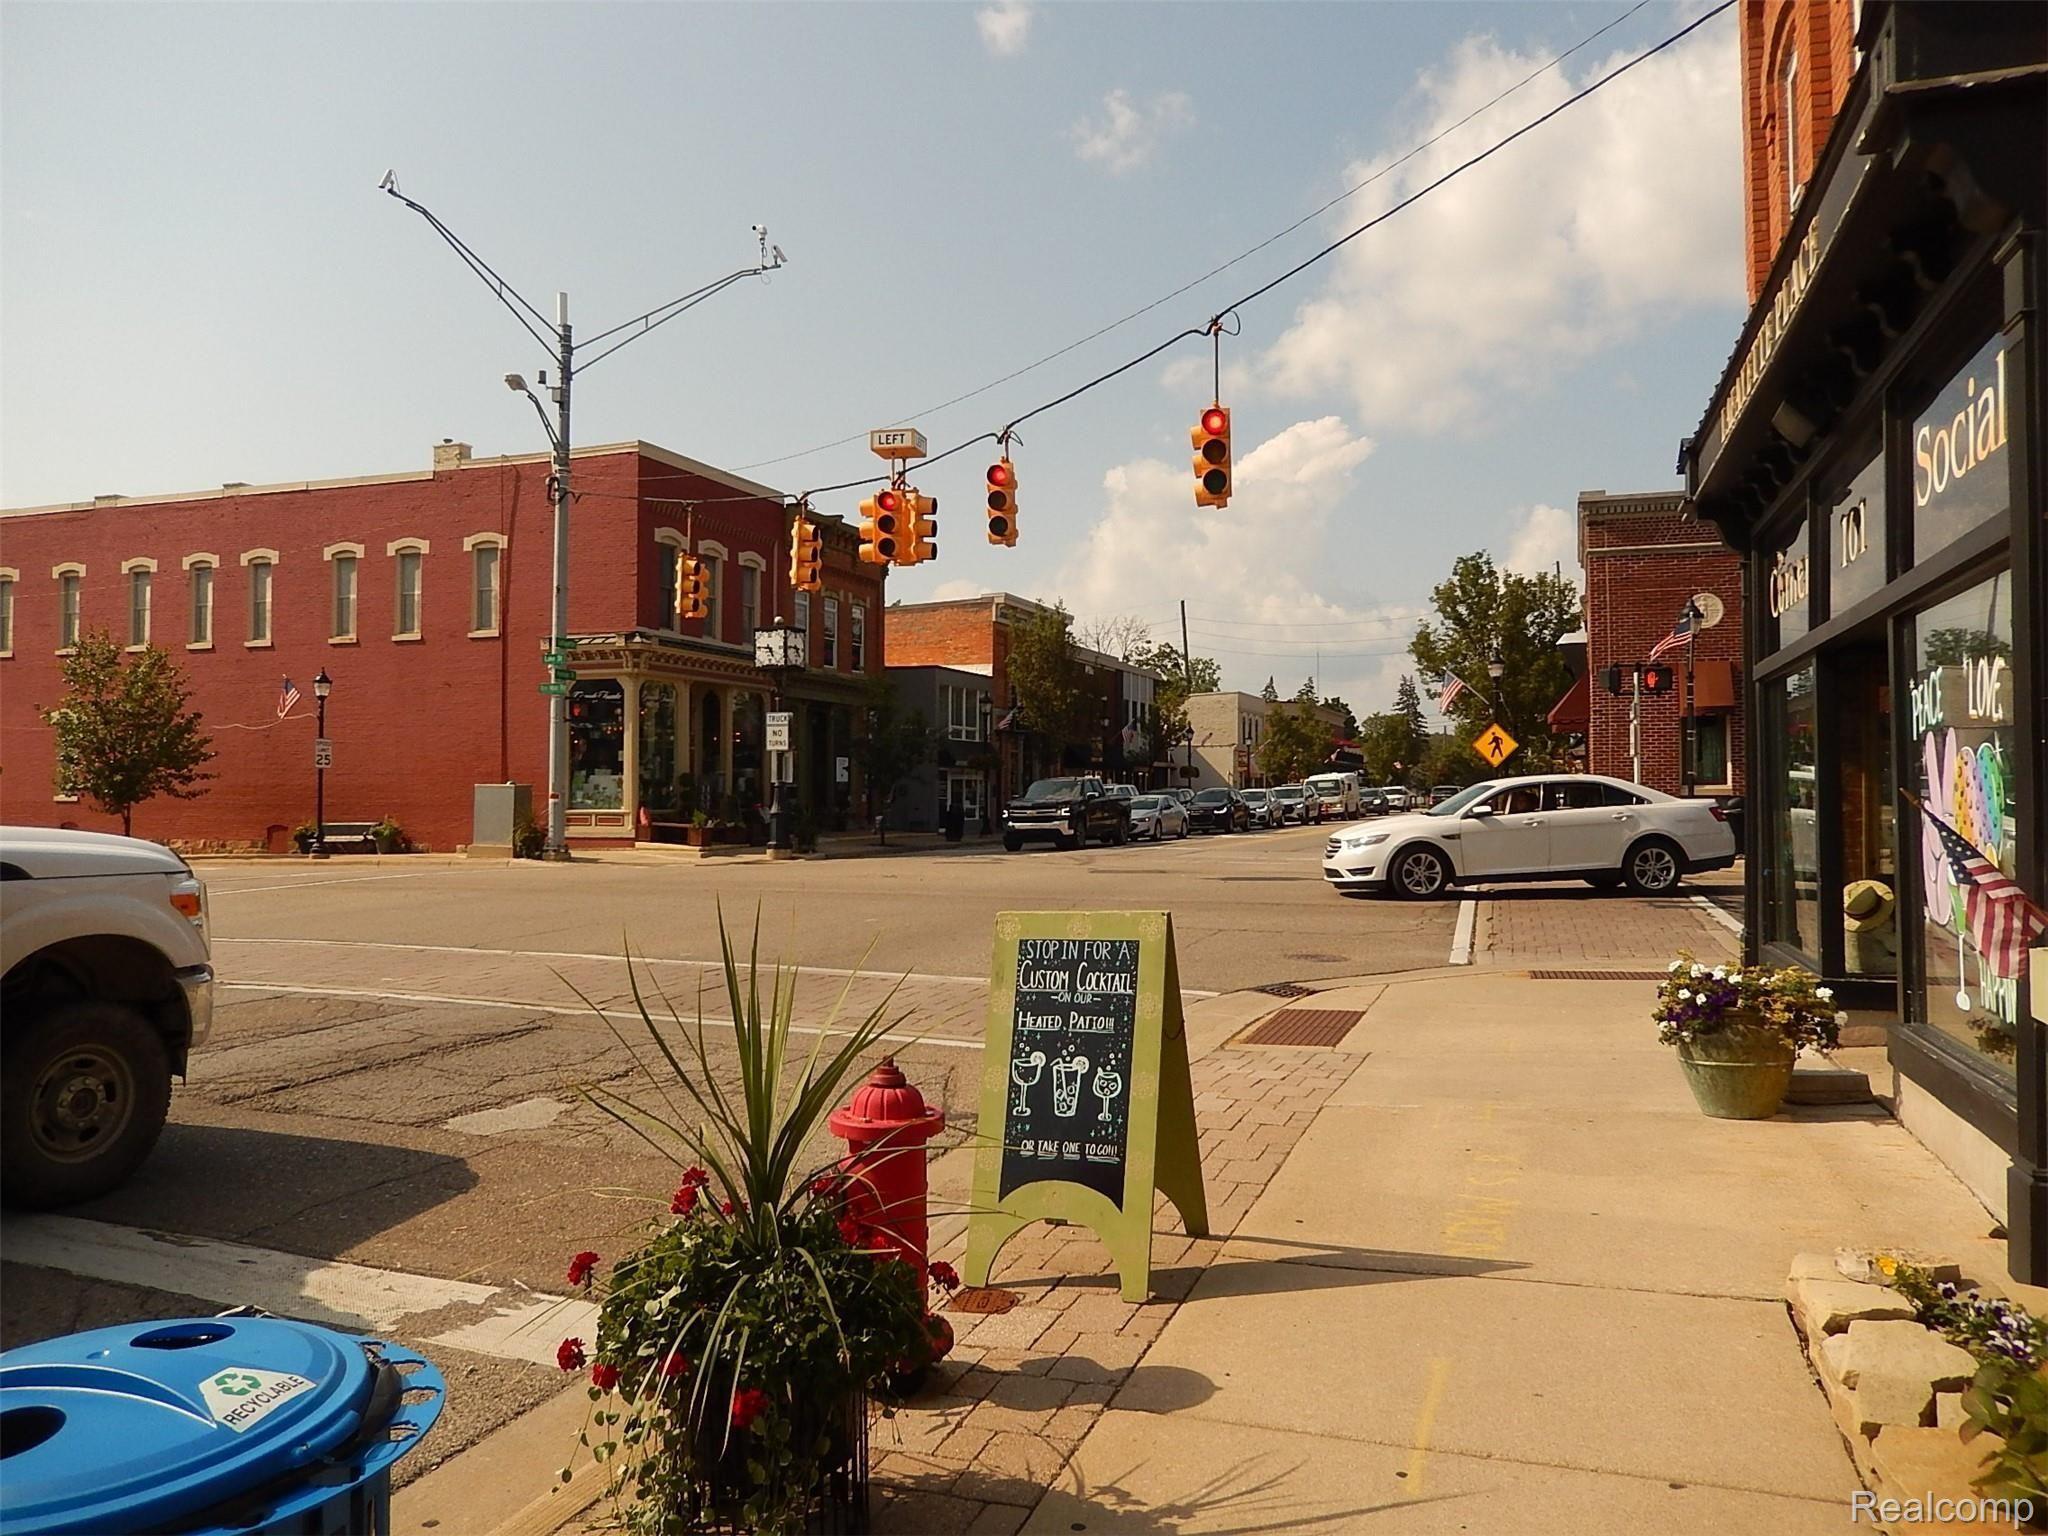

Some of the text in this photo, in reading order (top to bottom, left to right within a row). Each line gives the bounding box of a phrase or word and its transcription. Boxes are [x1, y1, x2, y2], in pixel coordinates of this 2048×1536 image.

[878, 433, 905, 445] LEFT
[1841, 499, 1867, 568] 101
[1916, 349, 2007, 507] Social
[1911, 654, 2006, 741] PEACE LOVE
[768, 739, 786, 747] TURNS
[316, 754, 331, 766] 25
[1027, 940, 1130, 960] STOP IN FOR A
[1020, 960, 1134, 993] CUSTOM COCKTAIL
[1018, 1011, 1062, 1028] HEATED
[1021, 1139, 1035, 1150] OR
[1038, 1140, 1060, 1153] TAKE
[1062, 1141, 1081, 1153] ONE
[1085, 1143, 1096, 1155] TO
[222, 1376, 305, 1425] RECYCLABLE
